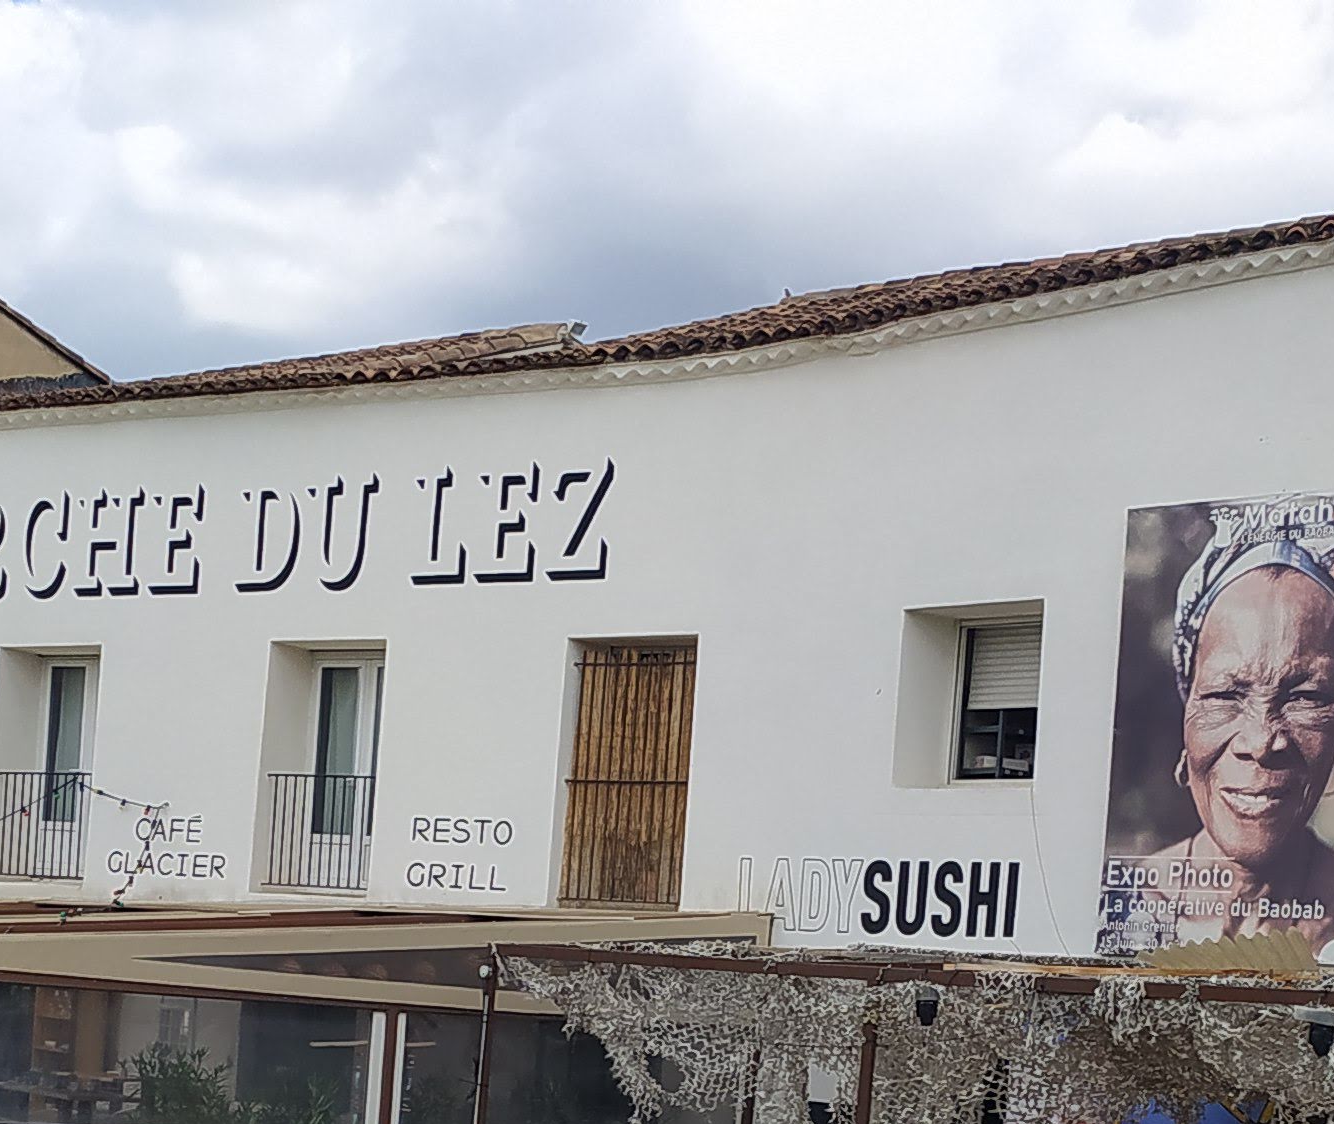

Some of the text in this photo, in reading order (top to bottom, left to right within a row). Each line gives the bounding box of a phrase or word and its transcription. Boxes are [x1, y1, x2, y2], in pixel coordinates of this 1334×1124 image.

[234, 472, 380, 593] DU
[410, 457, 616, 586] LEZ
[135, 815, 202, 843] CAFÉ
[412, 817, 513, 845] RESTO
[107, 850, 226, 878] GLACIER
[407, 862, 507, 892] GRILL
[1106, 860, 1234, 893] Expo Photo
[1104, 895, 1325, 921] La coopérative du Baobab
